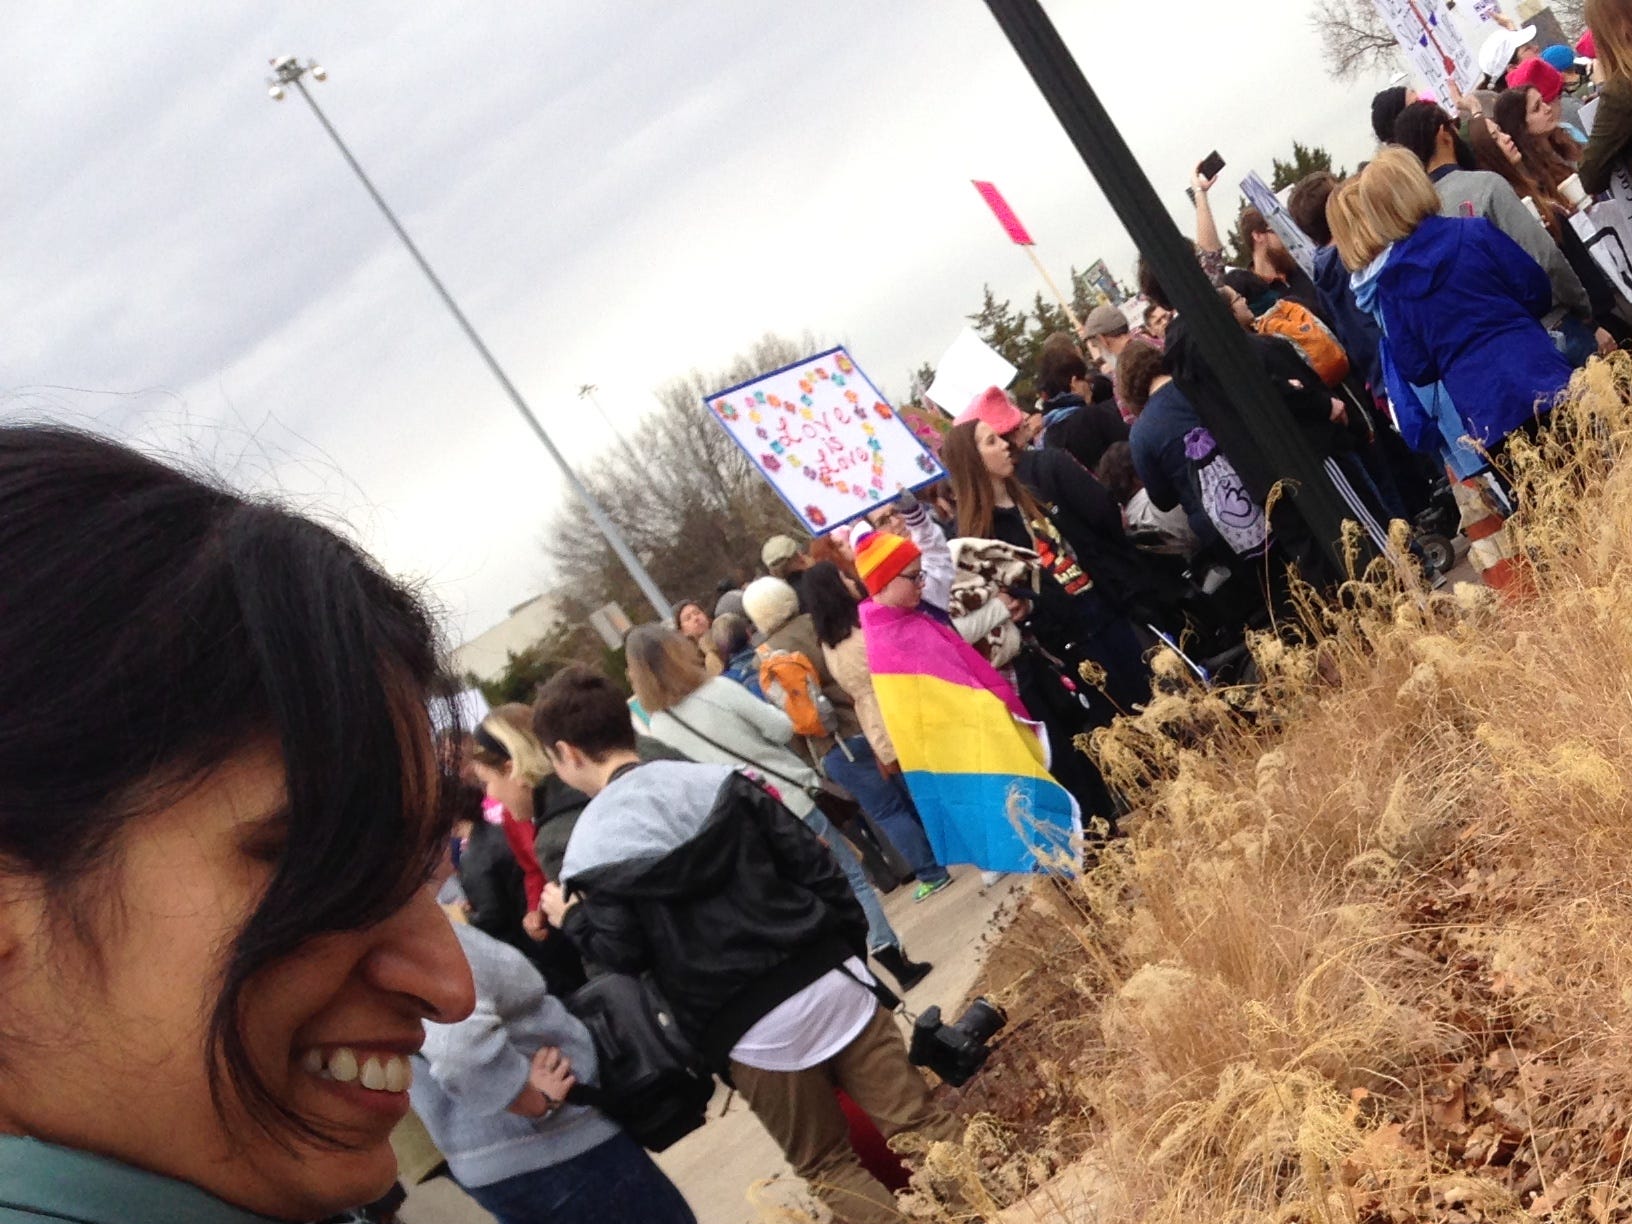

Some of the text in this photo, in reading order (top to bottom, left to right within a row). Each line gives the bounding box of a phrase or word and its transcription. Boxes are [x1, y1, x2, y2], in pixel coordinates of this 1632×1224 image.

[777, 407, 852, 447] Love
[821, 436, 844, 454] is
[816, 447, 869, 475] Love
